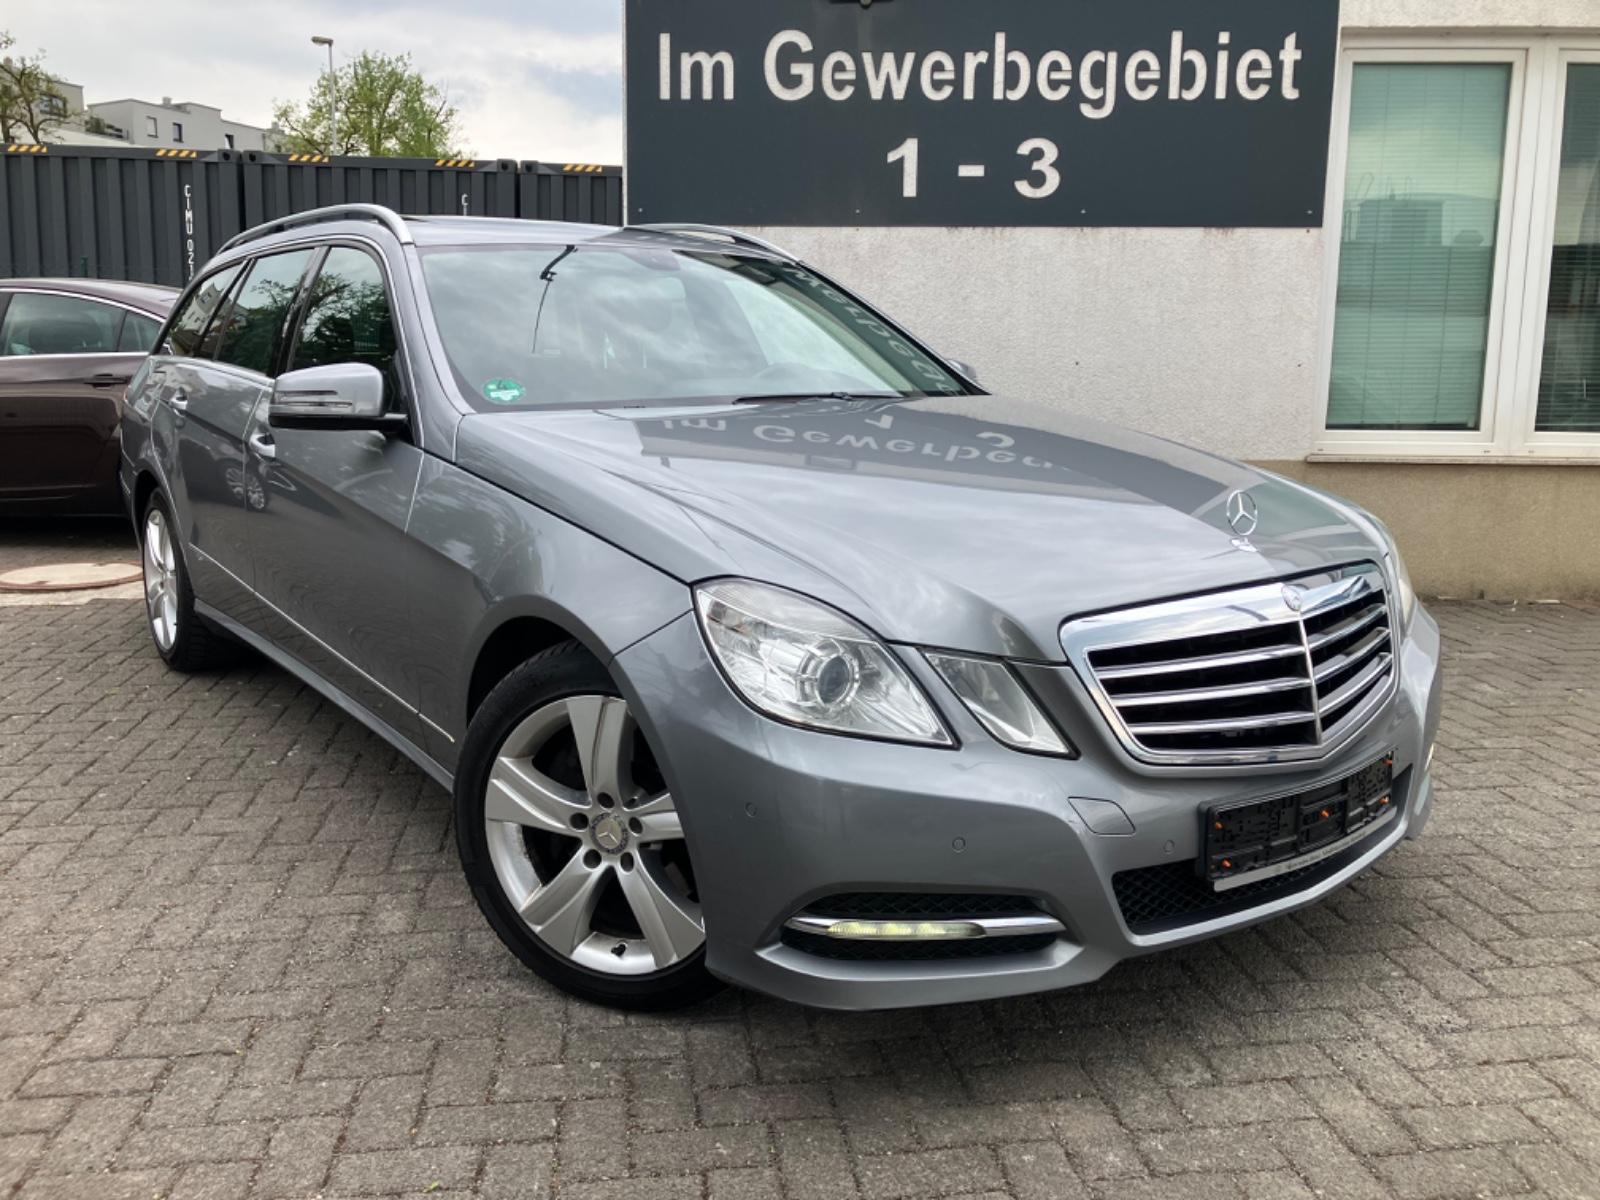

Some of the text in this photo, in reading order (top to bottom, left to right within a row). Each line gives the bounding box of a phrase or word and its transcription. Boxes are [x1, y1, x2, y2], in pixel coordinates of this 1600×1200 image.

[659, 29, 1302, 120] Im Gewerbegebiet
[886, 137, 1061, 199] 1 - 3
